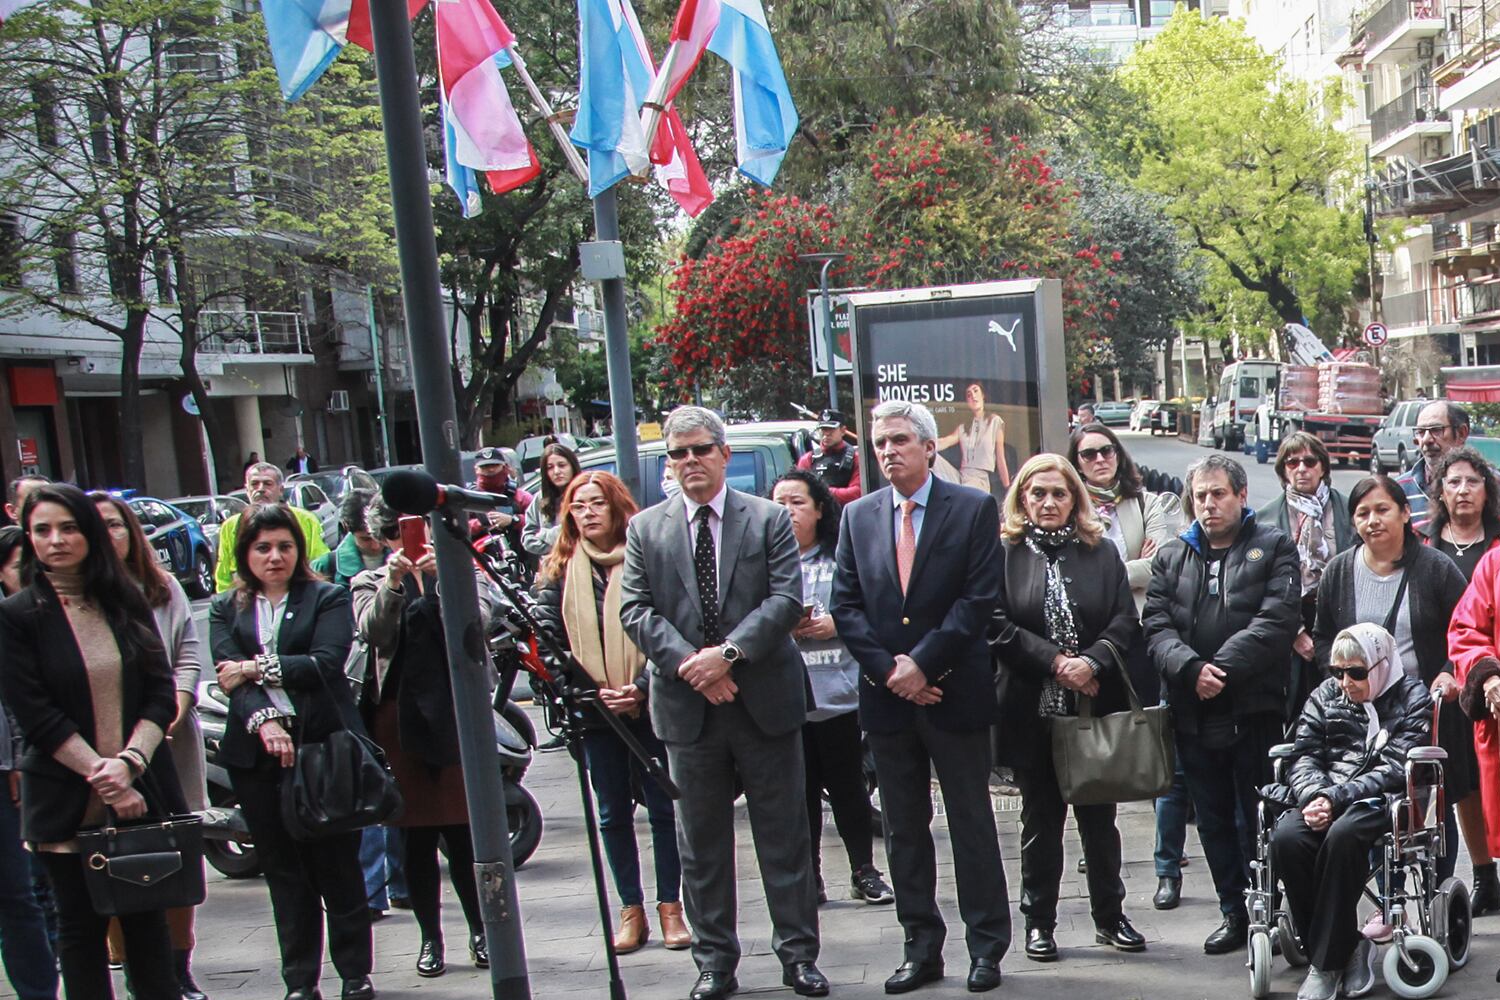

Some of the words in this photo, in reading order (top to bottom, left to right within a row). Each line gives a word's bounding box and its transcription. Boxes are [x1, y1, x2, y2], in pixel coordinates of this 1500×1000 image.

[878, 363, 908, 383] SHE
[879, 385, 929, 403] MOVES
[934, 383, 955, 402] US
